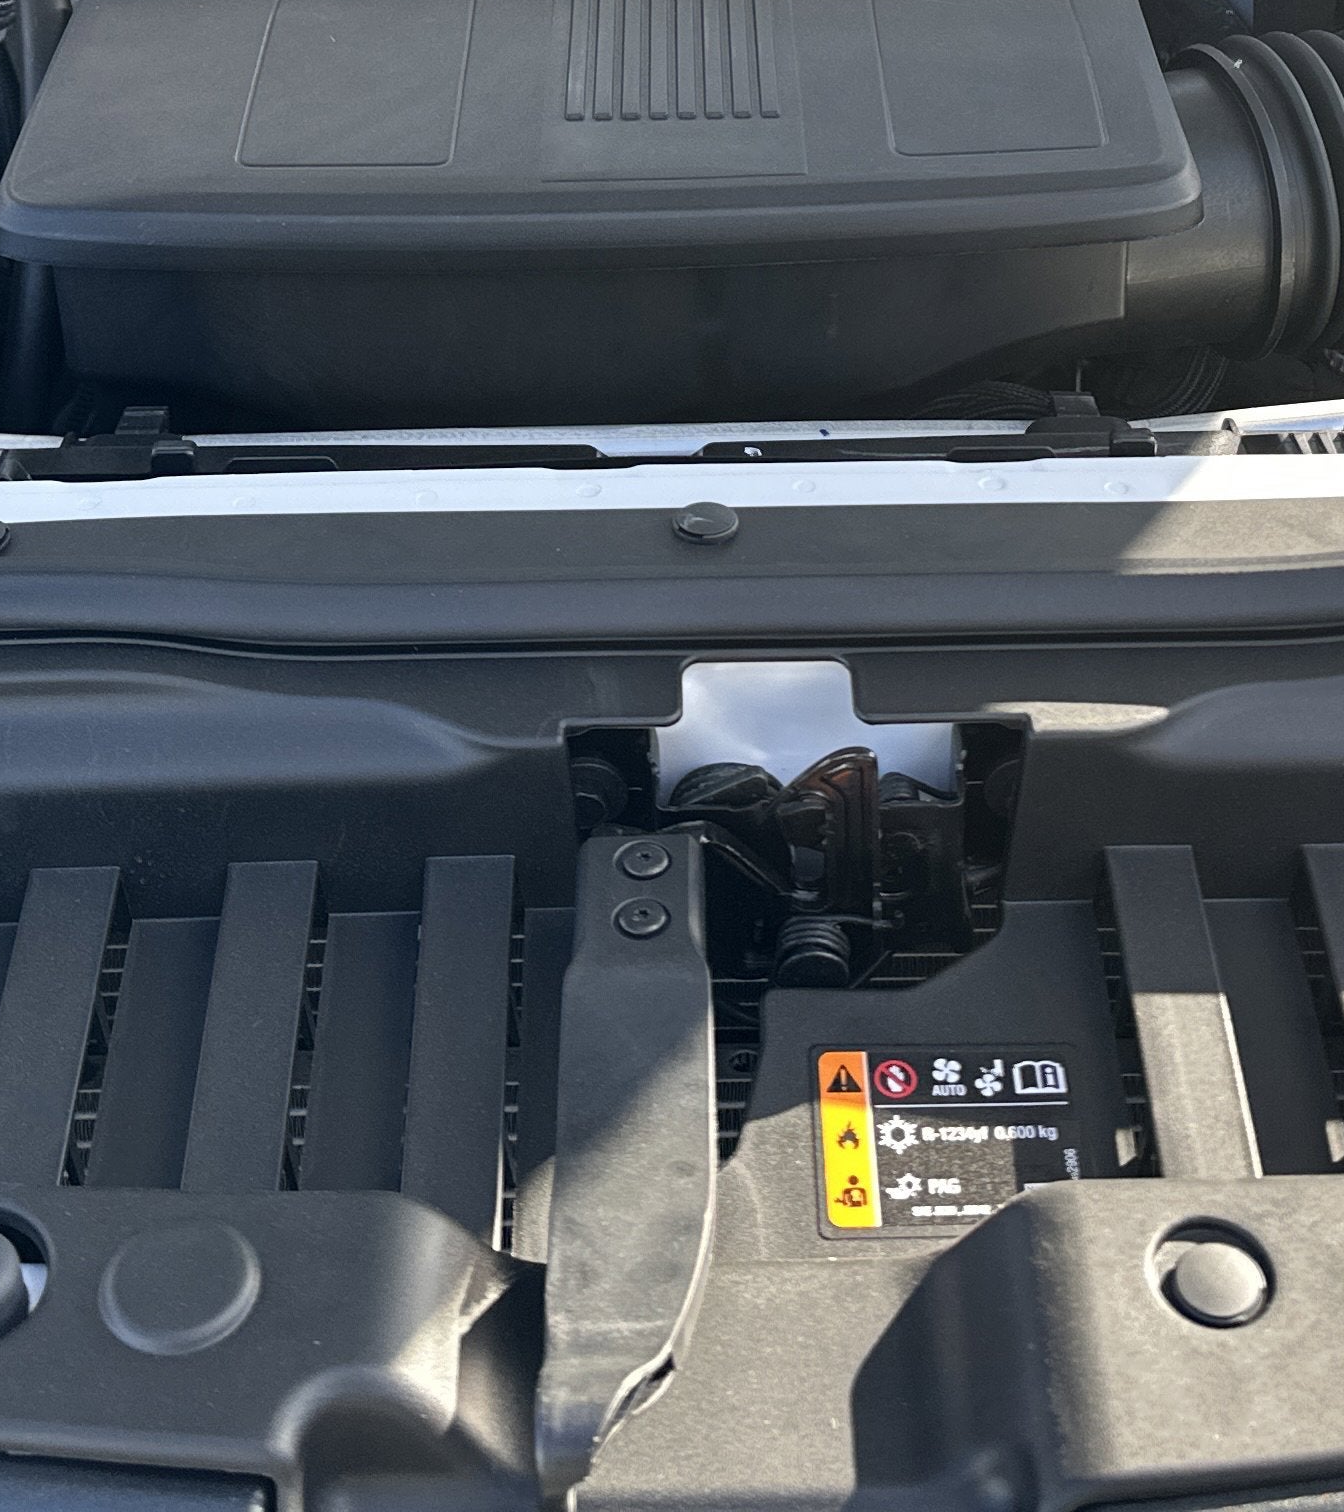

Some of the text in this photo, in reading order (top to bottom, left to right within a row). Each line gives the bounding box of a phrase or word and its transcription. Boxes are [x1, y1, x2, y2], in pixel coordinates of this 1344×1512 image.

[931, 1084, 968, 1096] AUTO
[1038, 1125, 1059, 1141] kg
[927, 1178, 962, 1195] PAG
